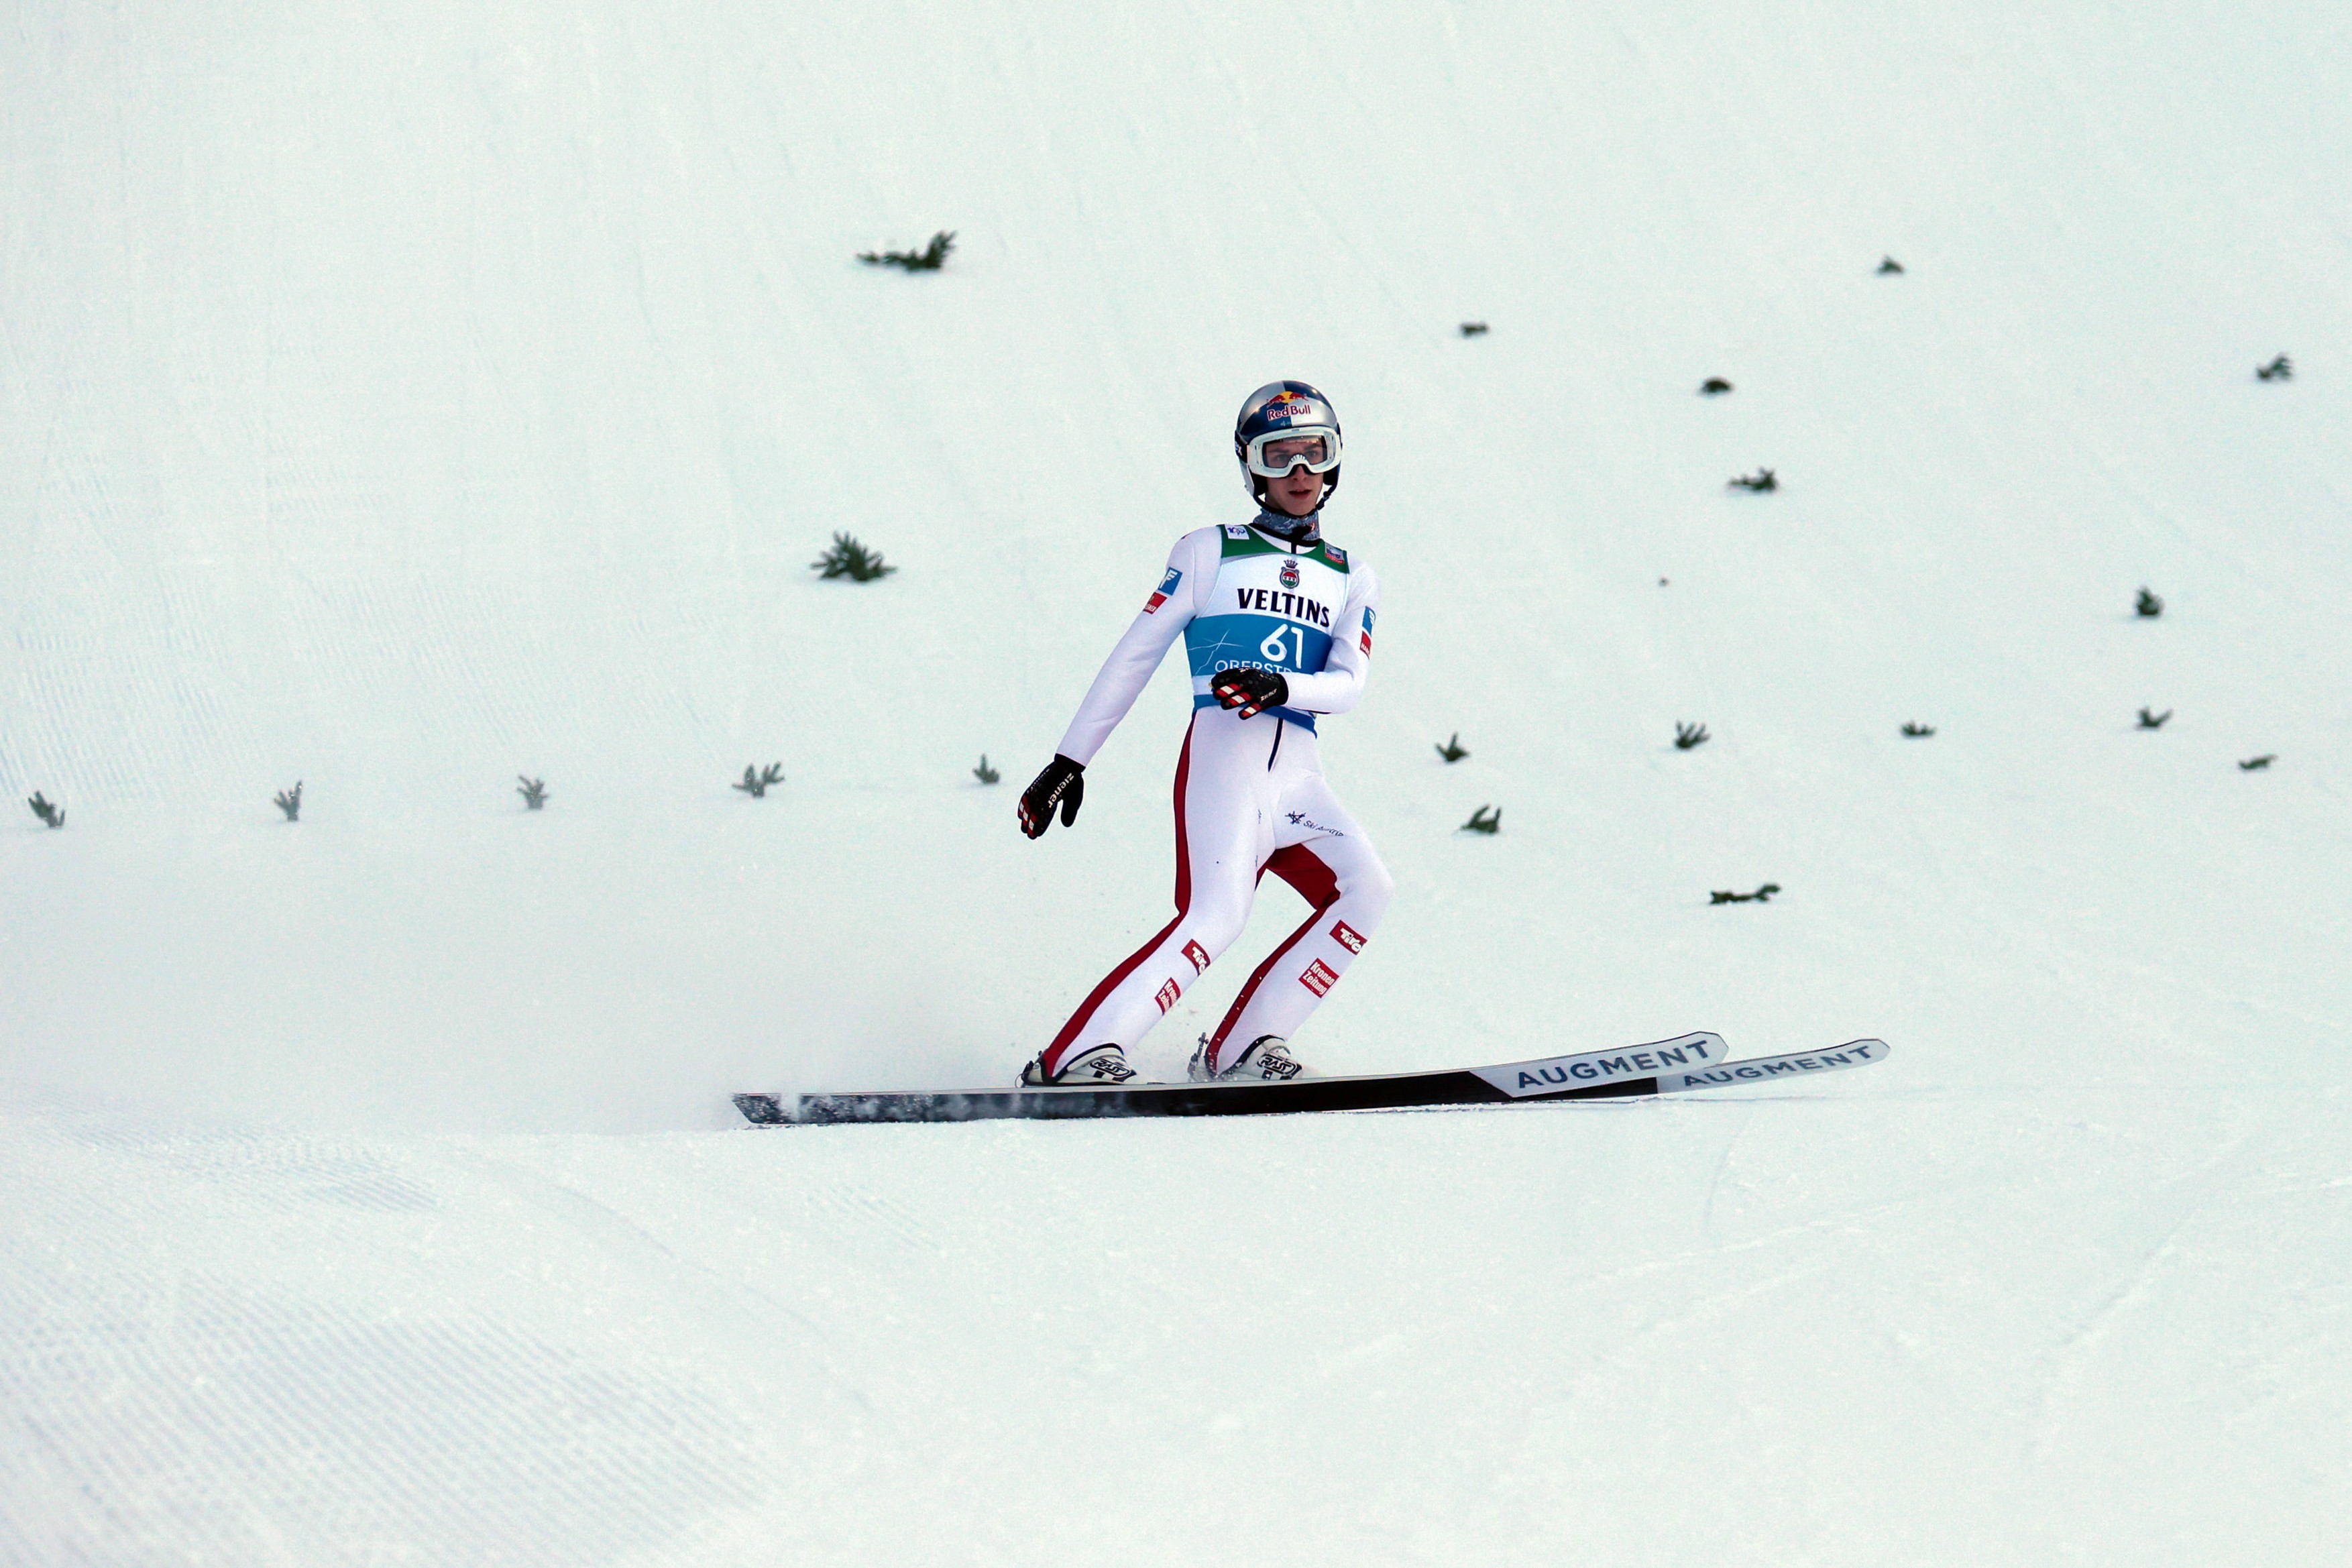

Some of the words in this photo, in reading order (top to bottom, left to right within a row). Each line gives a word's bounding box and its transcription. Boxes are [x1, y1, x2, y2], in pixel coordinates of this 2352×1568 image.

[1267, 405, 1289, 421] Red
[1290, 404, 1311, 415] Bull
[1237, 588, 1330, 627] VELTINS
[1260, 624, 1303, 669] 61
[1048, 773, 1074, 808] ziener
[1302, 970, 1328, 995] Zeitung
[1310, 962, 1335, 986] Kronen
[1518, 1040, 1707, 1088] AUGMENT
[1685, 1046, 1872, 1086] AUGMENT
